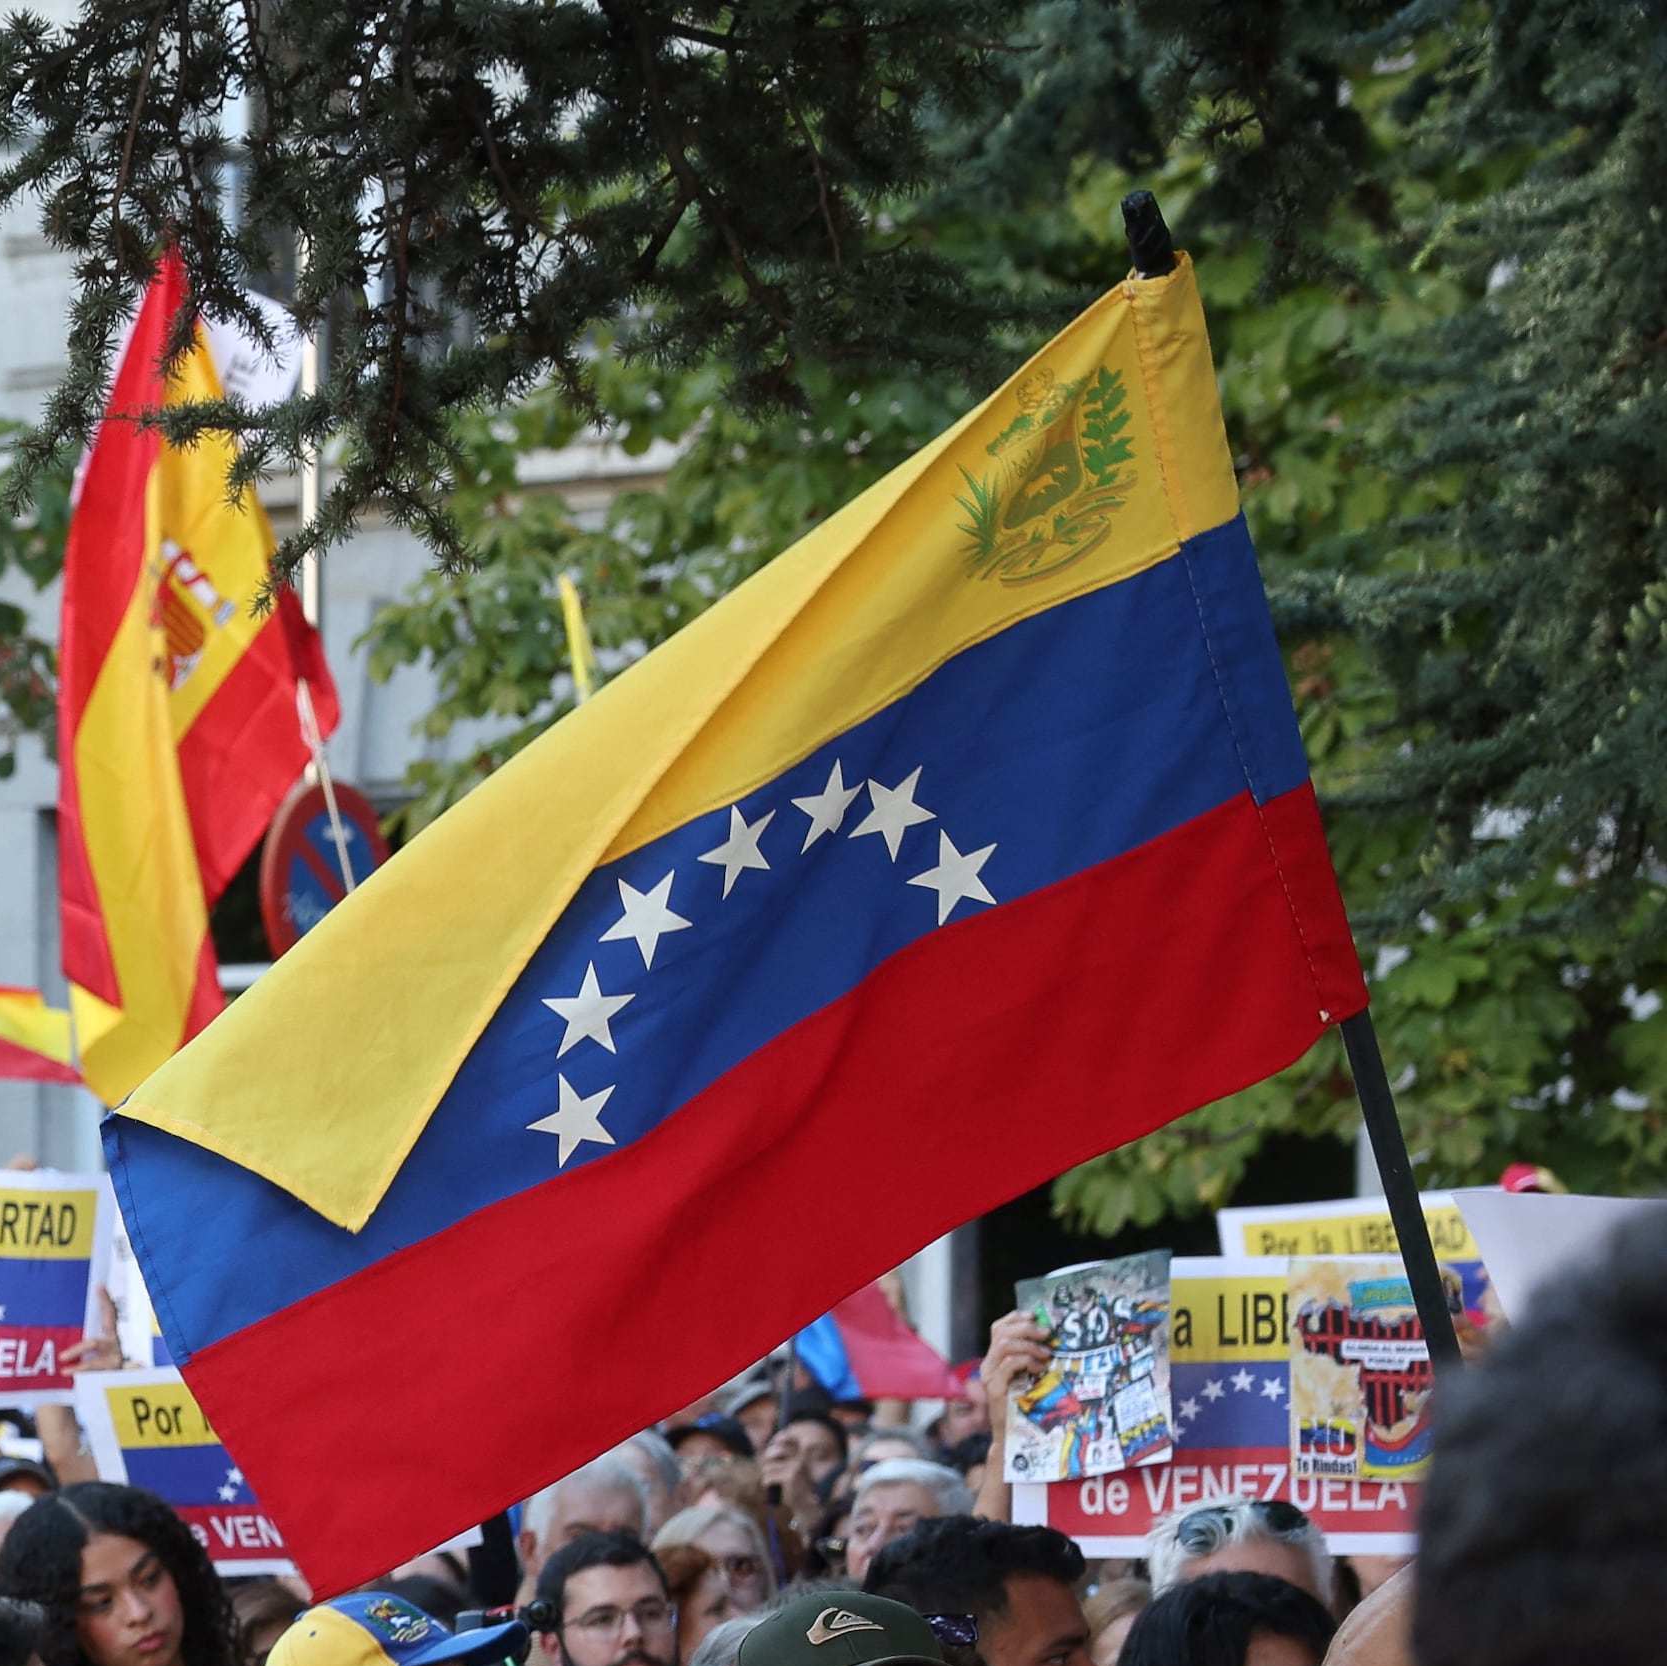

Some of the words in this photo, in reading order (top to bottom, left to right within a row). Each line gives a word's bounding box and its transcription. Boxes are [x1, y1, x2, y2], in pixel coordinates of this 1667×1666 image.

[1345, 1214, 1465, 1254] LIBEAD
[1174, 1306, 1192, 1347] a
[131, 1397, 181, 1436] Por
[1299, 1416, 1357, 1456] NO
[1079, 1475, 1130, 1515] de
